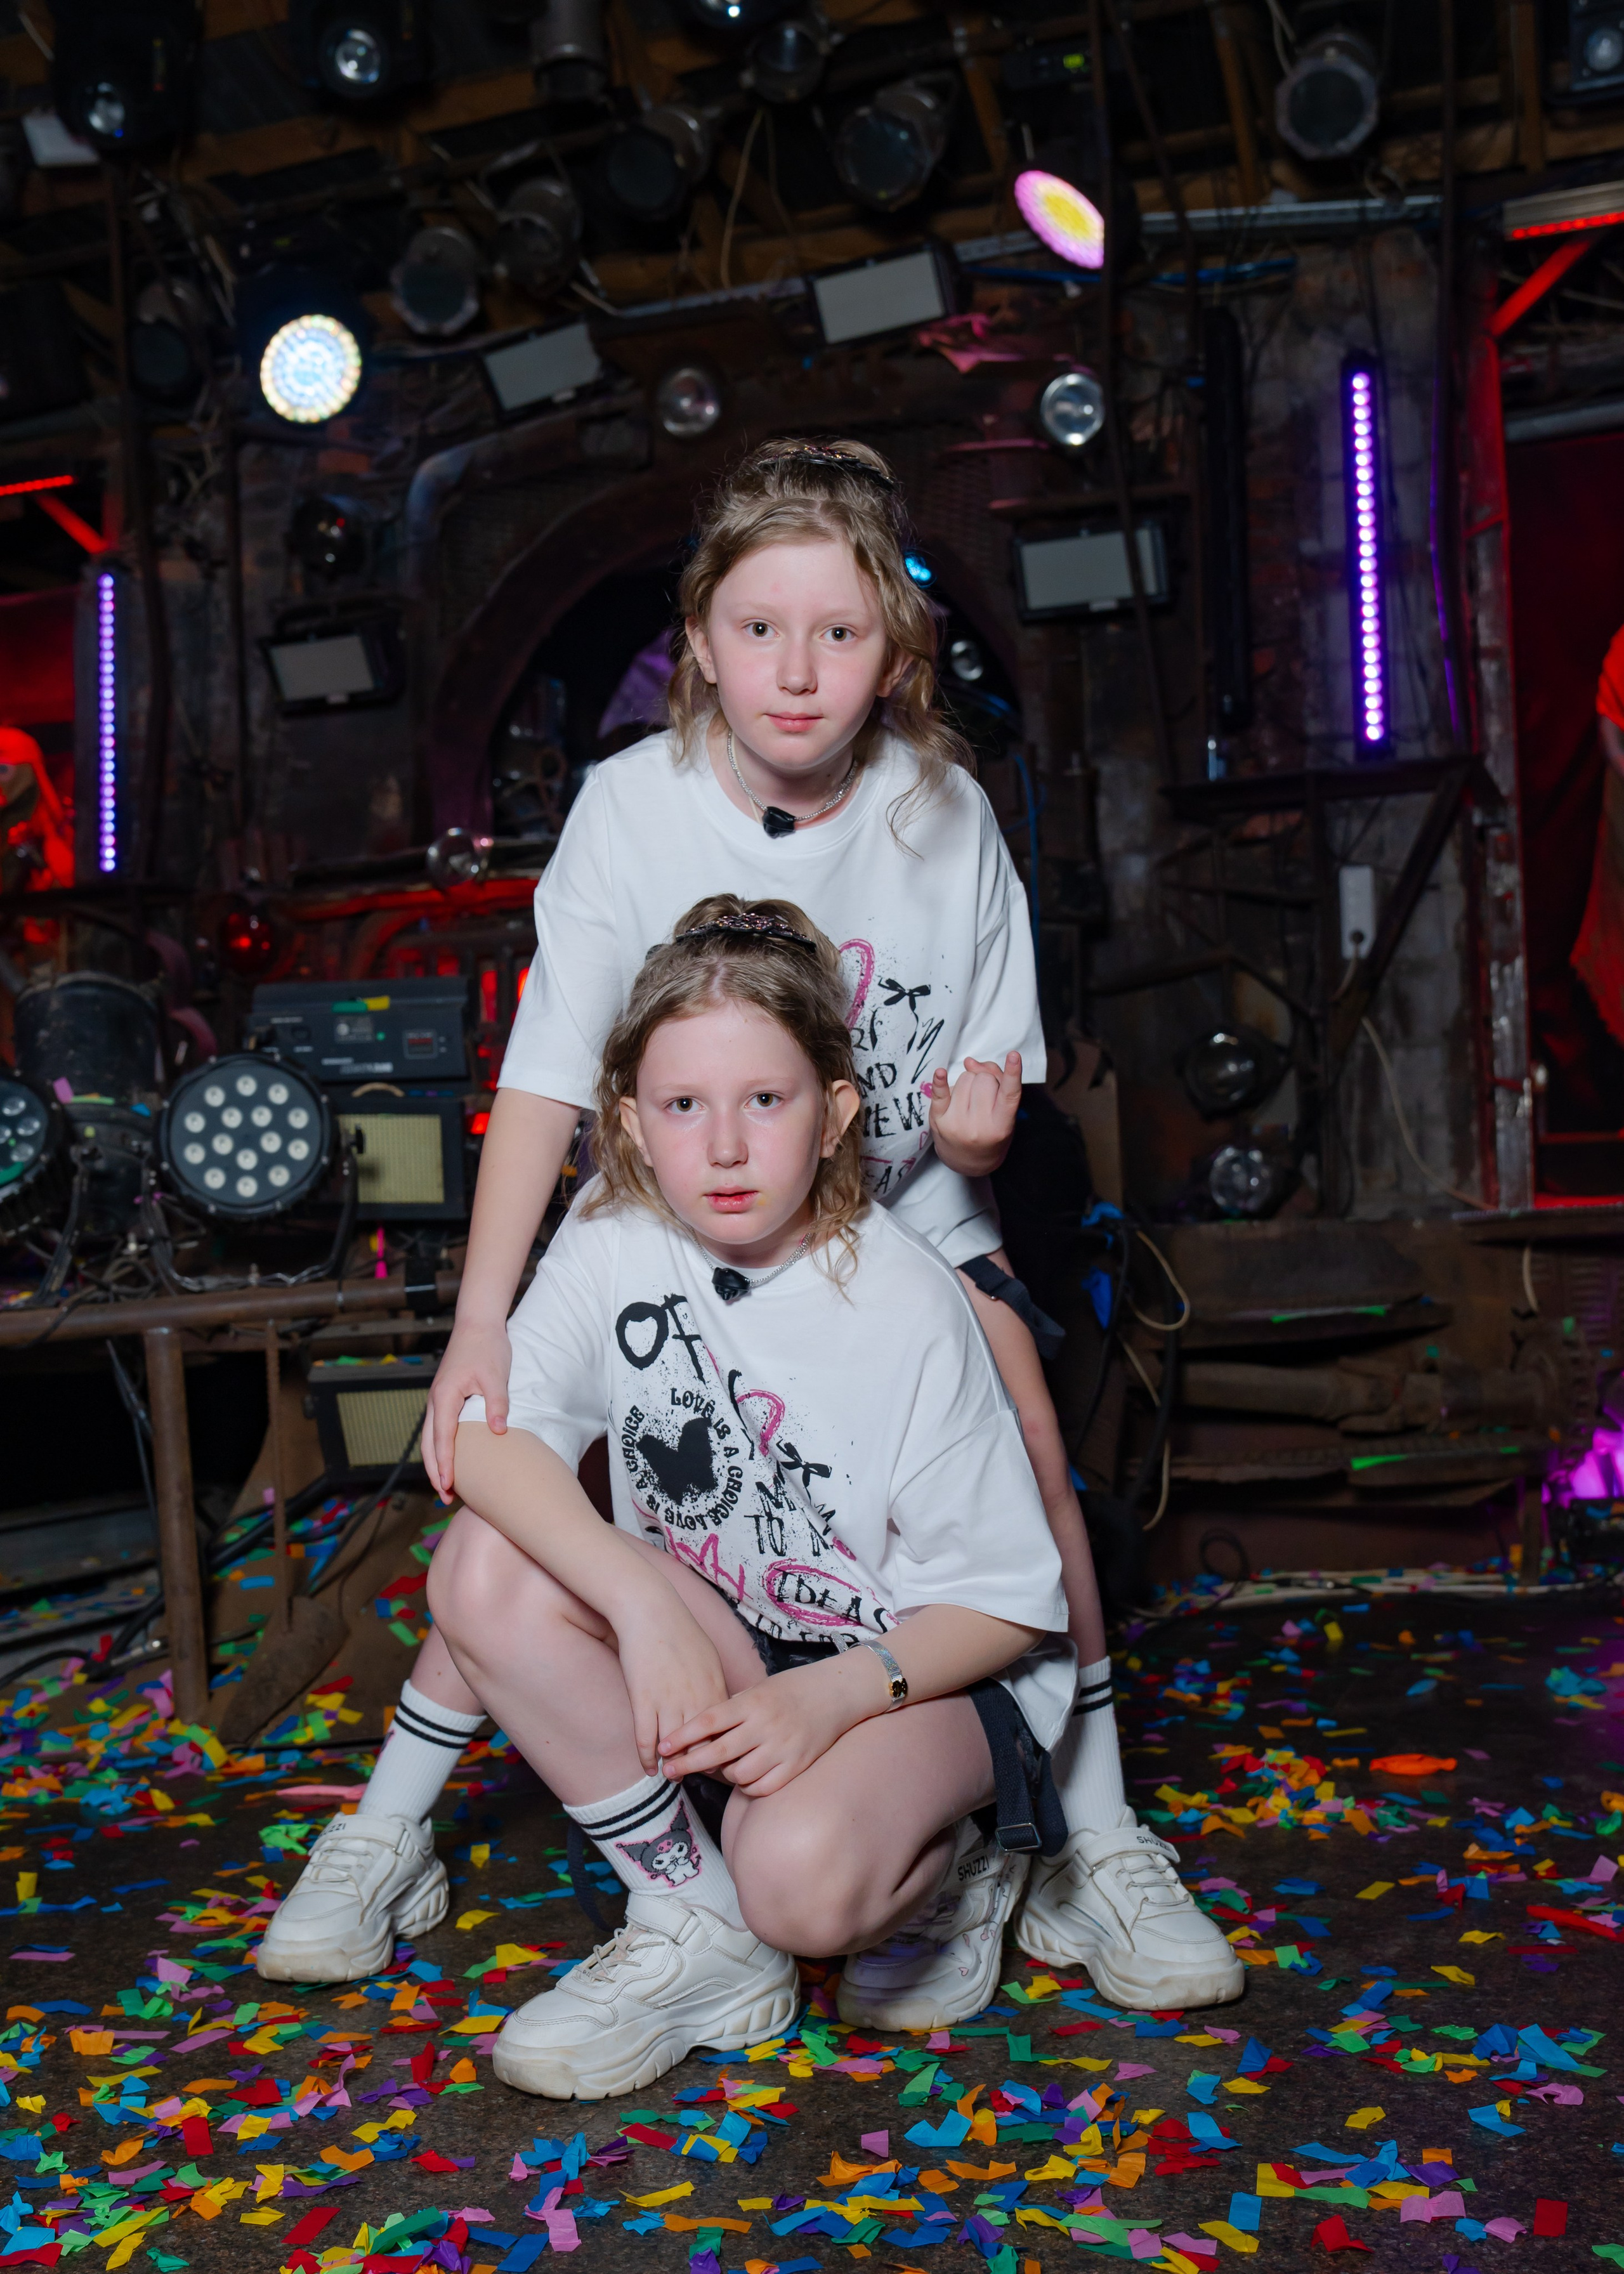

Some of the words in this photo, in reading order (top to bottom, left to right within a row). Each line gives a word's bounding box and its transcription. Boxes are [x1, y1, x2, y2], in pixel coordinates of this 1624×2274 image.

[671, 1388, 716, 1418] LOVE
[622, 1405, 645, 1473] CHOICE
[713, 1418, 731, 1439] IS
[723, 1446, 739, 1458] A
[635, 1477, 648, 1490] A
[646, 1494, 660, 1514] IS
[707, 1465, 743, 1526] CHOICE
[665, 1508, 708, 1530] LOVE
[744, 1515, 786, 1557] TO
